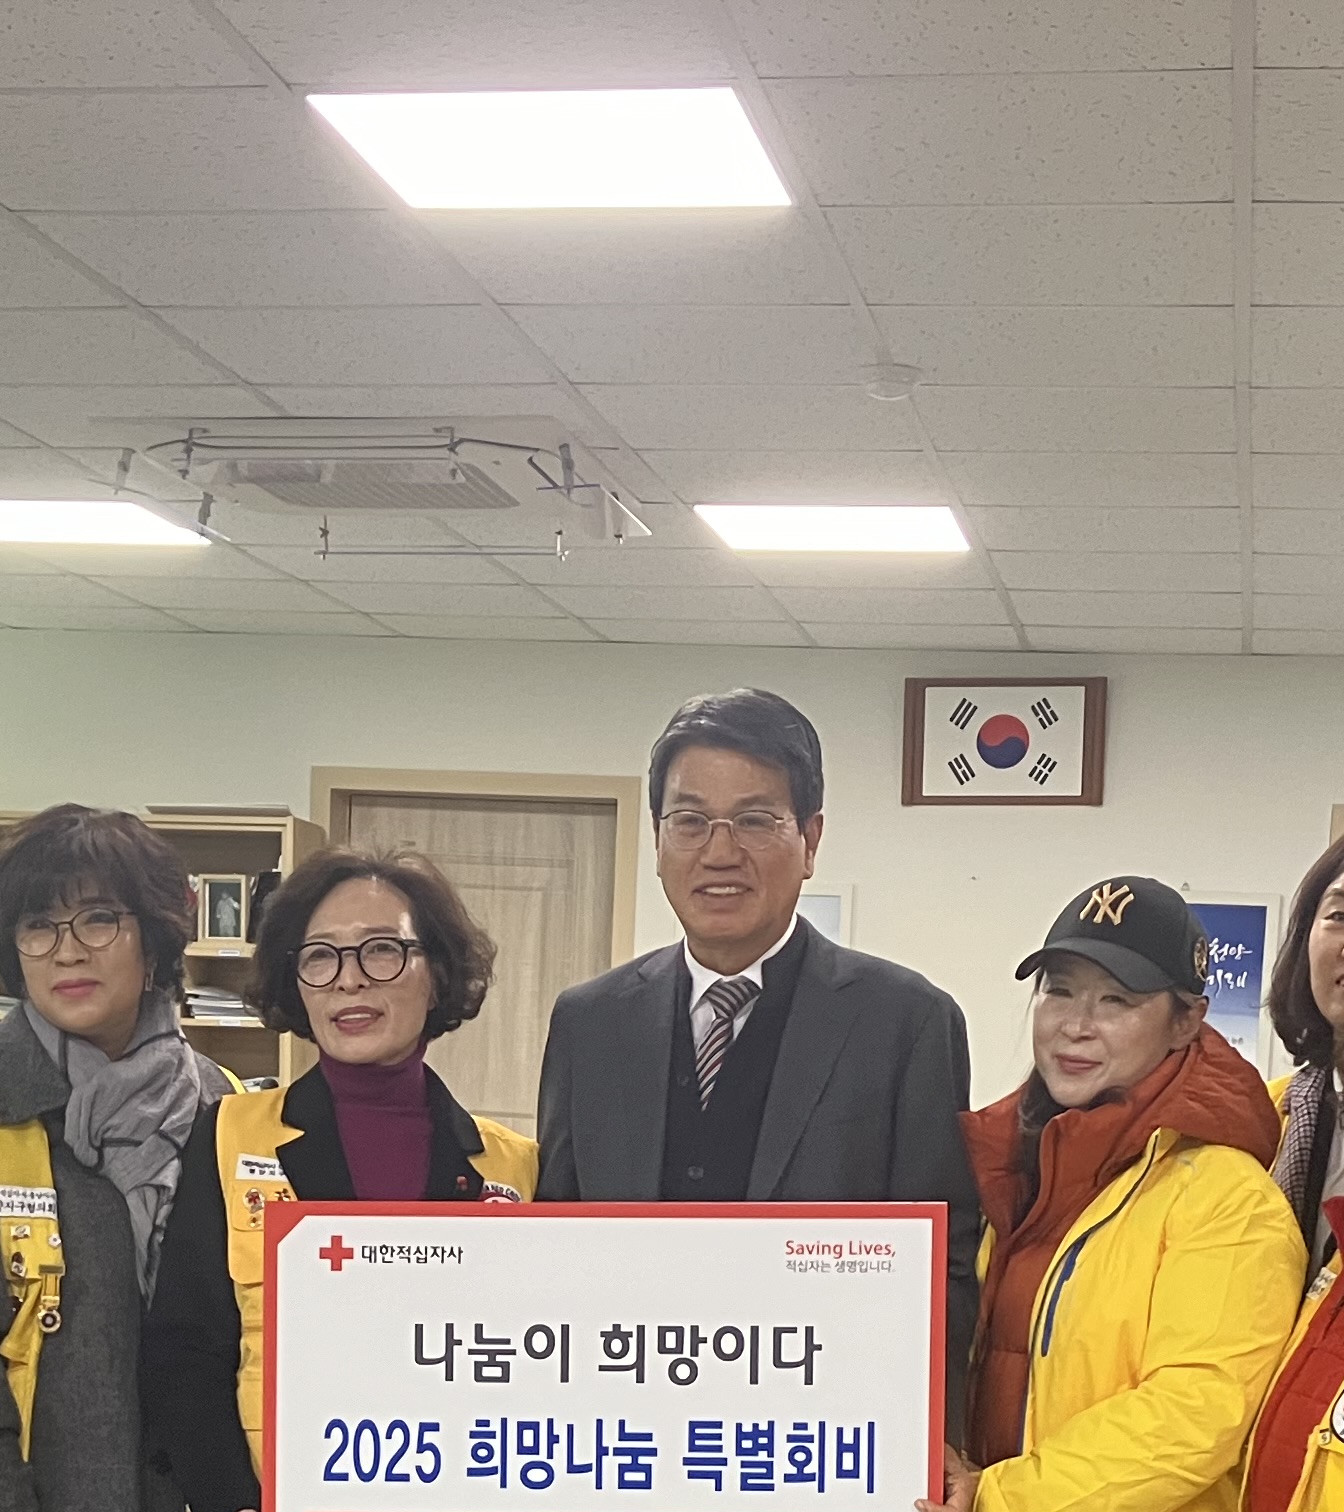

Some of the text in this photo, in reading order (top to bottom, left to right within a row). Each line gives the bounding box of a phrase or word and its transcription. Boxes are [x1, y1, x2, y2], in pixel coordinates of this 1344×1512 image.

[1079, 882, 1135, 926] NY
[361, 1243, 464, 1265] 대한적십자사
[785, 1240, 896, 1260] Saving Lives,
[786, 1260, 831, 1273] 적십자는
[414, 1322, 823, 1386] 나눔이 희망이다
[322, 1416, 876, 1494] 2025 희망나눔 특별회비
